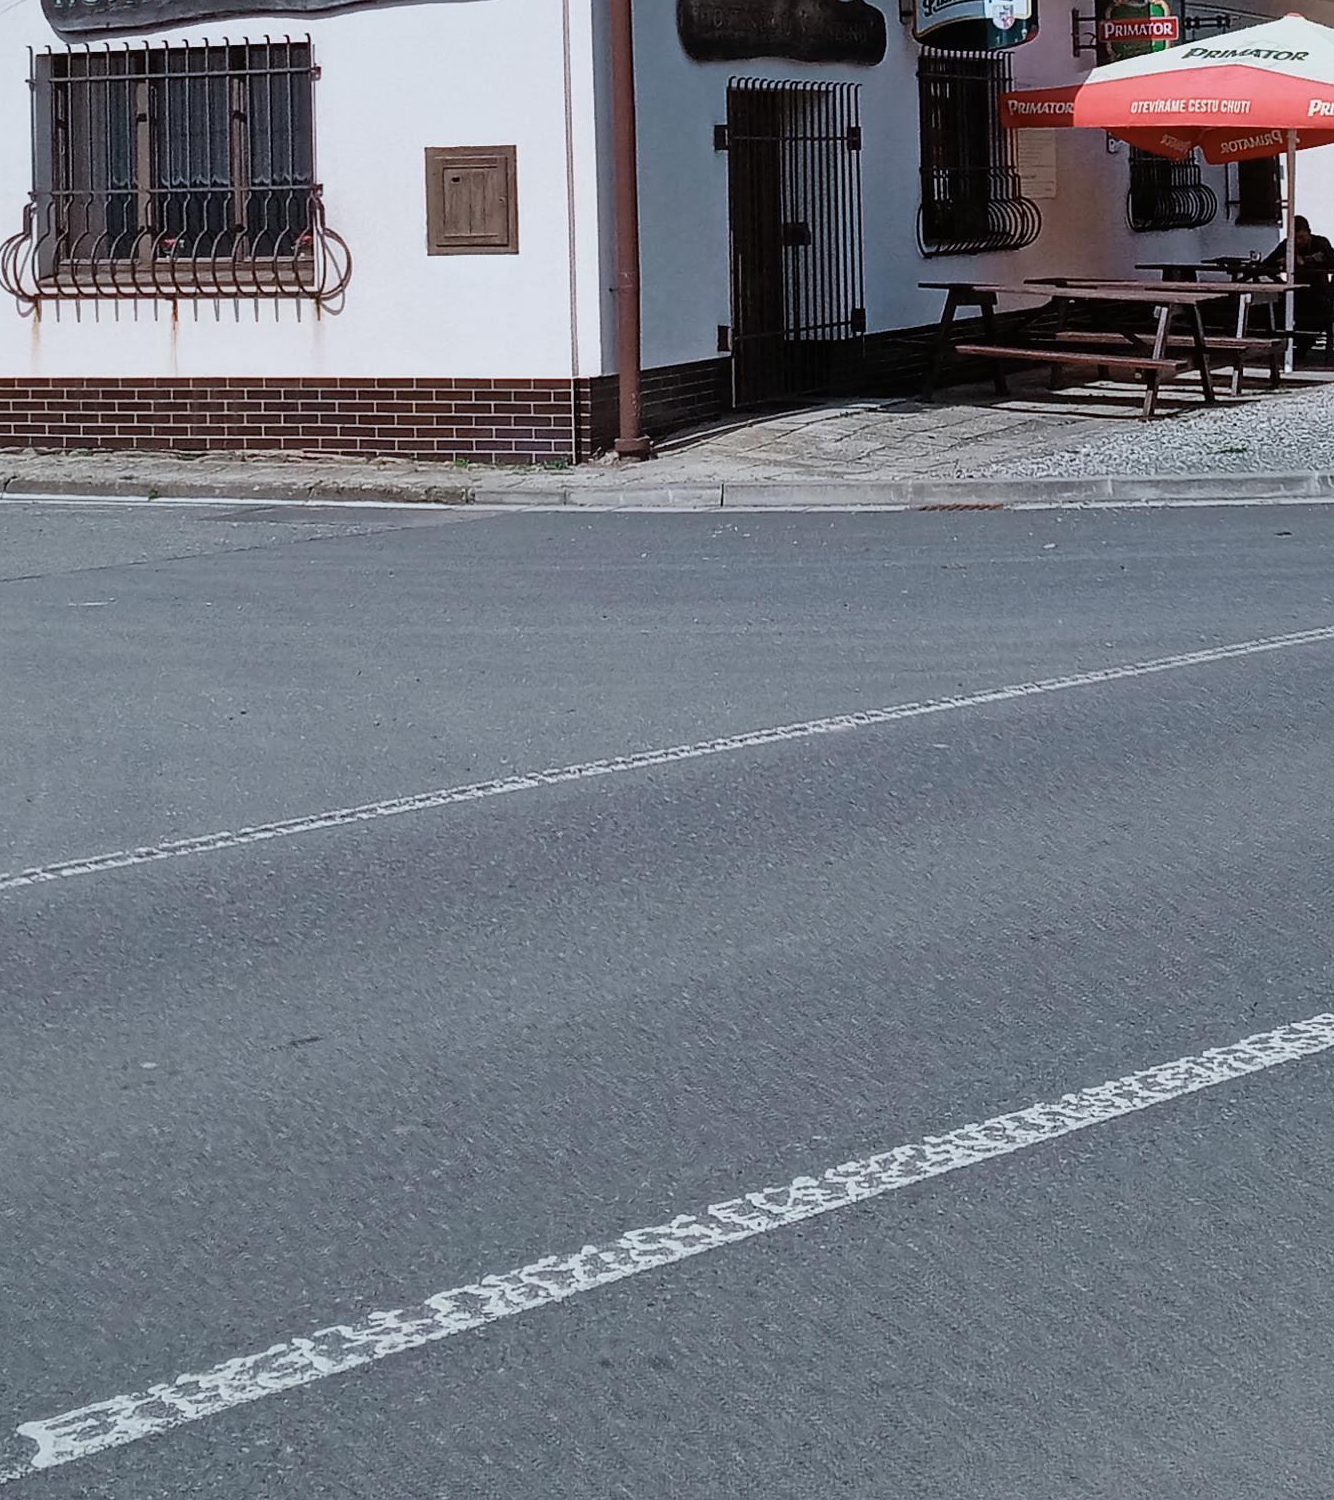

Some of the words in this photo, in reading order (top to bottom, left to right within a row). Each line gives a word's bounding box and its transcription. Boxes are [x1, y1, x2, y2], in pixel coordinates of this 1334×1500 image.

[1104, 22, 1173, 38] PRIMATOR
[1181, 47, 1310, 61] PRIMATOR
[1007, 100, 1075, 116] PRIMATOR
[1130, 99, 1186, 113] OTEVÍRÁME
[1188, 99, 1219, 112] CESTU
[1220, 100, 1252, 113] CHUTI
